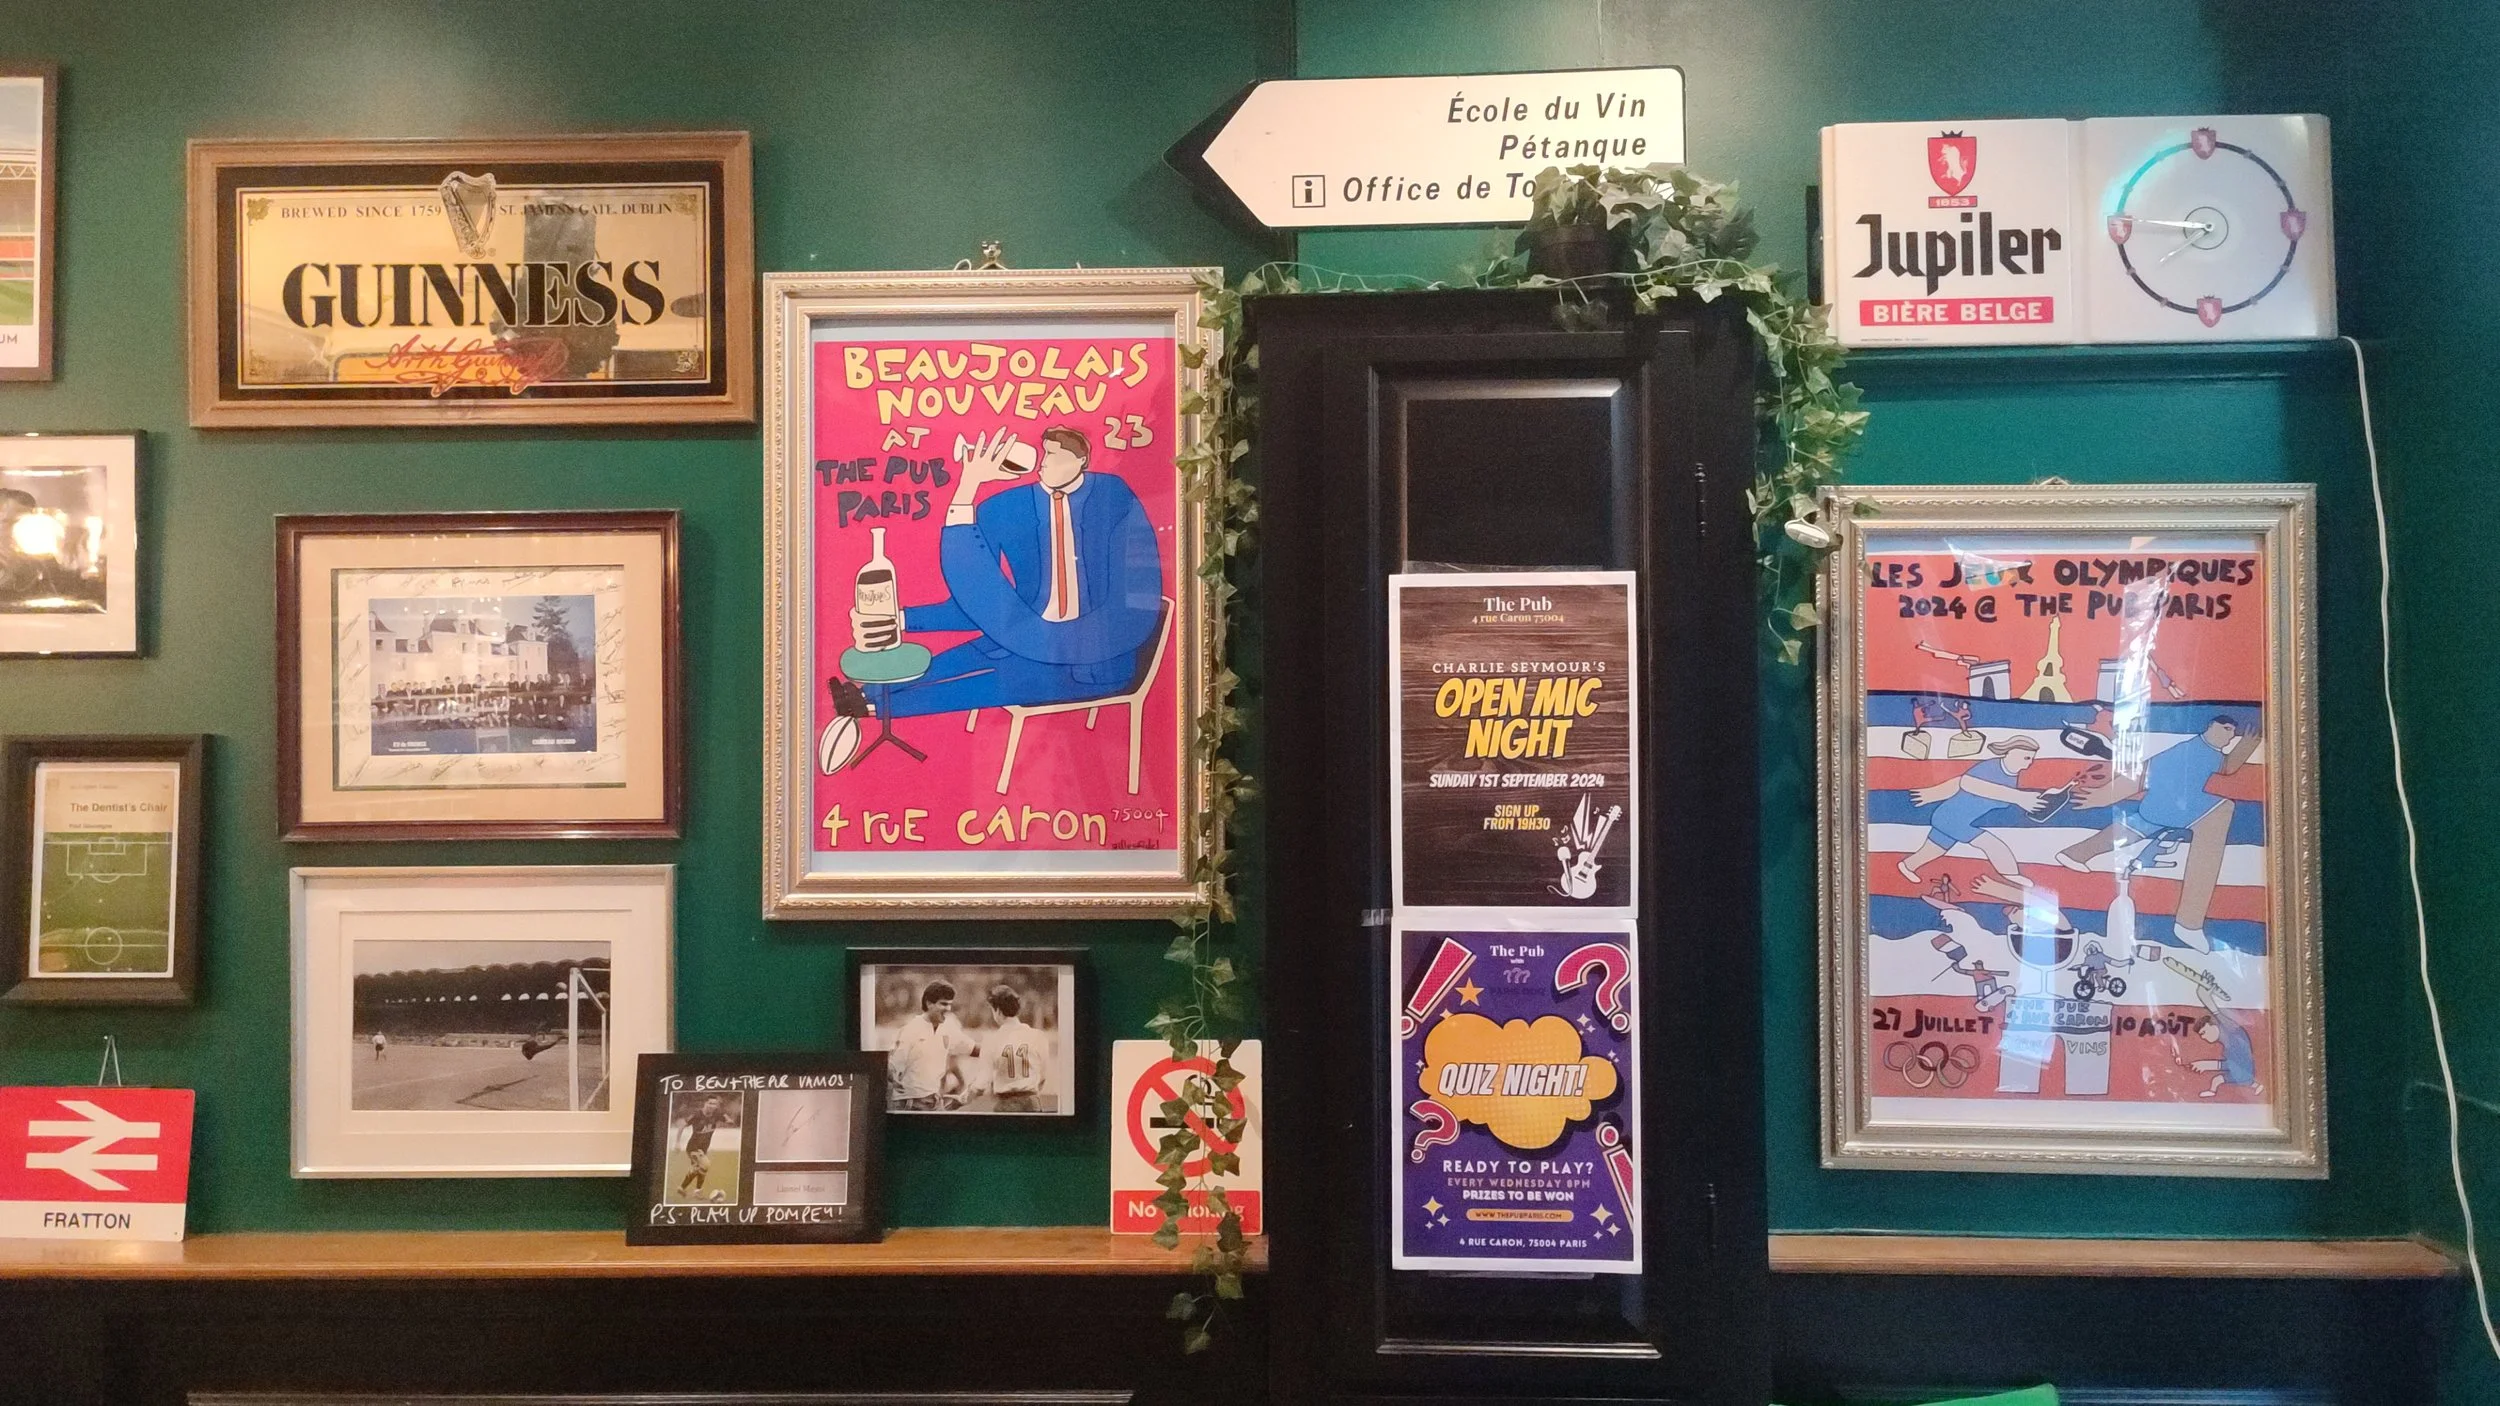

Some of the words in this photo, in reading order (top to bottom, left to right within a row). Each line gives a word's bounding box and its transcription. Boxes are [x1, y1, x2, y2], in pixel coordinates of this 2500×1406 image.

[1448, 91, 1528, 123] École
[1545, 95, 1580, 119] du
[1597, 92, 1647, 118] Vin
[1500, 133, 1648, 163] Pétanque
[1343, 174, 1440, 203] Office
[1457, 173, 1491, 200] de
[1505, 172, 1537, 199] To
[281, 206, 347, 218] BREWED
[356, 204, 402, 218] SINCE
[411, 204, 442, 217] 1759
[500, 203, 516, 216] ST.
[622, 202, 672, 215] DUBLIN
[1852, 211, 2062, 297] Jupiler
[283, 261, 665, 327] GUINNESS
[1873, 301, 1949, 323] BIÈRE
[1961, 302, 2043, 321] BELGE
[843, 342, 1149, 388] BEAUJOLAIS
[877, 382, 1108, 425] NOUVEAU
[881, 426, 931, 452] AT
[1103, 414, 1155, 450] 23
[815, 457, 877, 486] THE
[884, 456, 950, 487] PUB
[837, 490, 931, 528] PARIS
[1871, 562, 1924, 588] LES
[2053, 558, 2256, 588] OLYMPIQUES
[1484, 596, 1515, 612] The
[1520, 596, 1553, 612] Pub
[1898, 594, 1967, 620] 2024
[1974, 595, 1998, 623] @
[2015, 593, 2073, 617] THE
[2087, 590, 2139, 620] PUB
[1472, 615, 1479, 625] 4
[1480, 615, 1499, 624] rue
[1500, 613, 1532, 624] Caron
[1533, 613, 1565, 625] 75004
[1432, 661, 1505, 674] CHARLIE
[1511, 661, 1607, 673] SEYMOUR'S
[1435, 676, 1528, 719] OPEN
[1530, 676, 1604, 718] MIC
[1463, 718, 1575, 760] NIGHT
[1429, 773, 1477, 789] SUNDAY
[1478, 774, 1500, 788] 1ST
[1501, 773, 1568, 788] SEPTEMBER
[1571, 773, 1605, 788] 2024
[70, 802, 89, 813] The
[91, 802, 137, 813] Dentist's
[140, 802, 168, 813] Chair
[1494, 804, 1522, 818] SIGN
[1524, 804, 1540, 817] UP
[822, 803, 850, 847] 4
[1111, 808, 1169, 834] 75004
[1483, 817, 1514, 830] FROM
[1517, 817, 1551, 830] 19H30
[1489, 944, 1516, 957] The
[1519, 944, 1545, 957] Pub
[2054, 1000, 2091, 1013] PUB
[1872, 1006, 1902, 1031] 27
[1903, 1008, 1994, 1038] JUILLET
[2054, 1013, 2109, 1027] CARON
[2115, 1015, 2137, 1036] 10
[2066, 1040, 2107, 1056] VINS
[1001, 1043, 1030, 1079] 11
[659, 1074, 684, 1095] TO
[1438, 1062, 1500, 1098] QUIZ
[1502, 1063, 1588, 1097] NIGHT!
[1443, 1160, 1501, 1174] READY
[1508, 1161, 1533, 1175] TO
[1541, 1161, 1595, 1175] PLAY?
[1447, 1178, 1484, 1188] EVERY
[1488, 1178, 1561, 1189] WEDNESDAY
[1462, 1190, 1505, 1201] PRIZES
[1507, 1190, 1525, 1201] TO
[1527, 1190, 1542, 1201] BE
[1544, 1191, 1574, 1201] WON
[690, 1206, 730, 1223] PLAY
[738, 1206, 758, 1223] UP
[1128, 1200, 1157, 1218] No
[43, 1212, 131, 1229] FRATTON
[1459, 1238, 1466, 1247] 4
[1468, 1238, 1487, 1247] RUE
[1489, 1238, 1526, 1249] CARON,
[1529, 1238, 1557, 1248] 75004
[1560, 1239, 1588, 1248] PARIS
